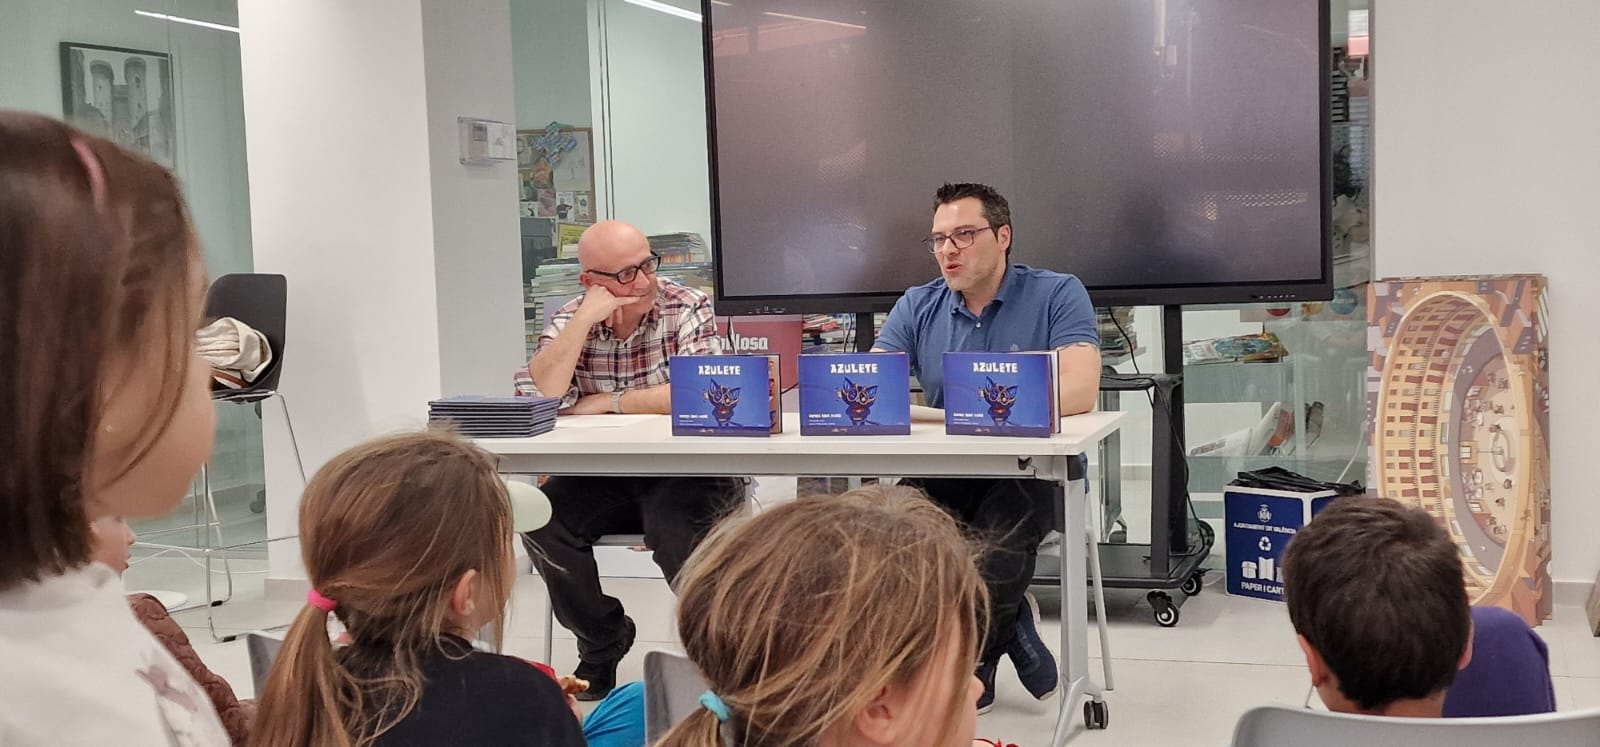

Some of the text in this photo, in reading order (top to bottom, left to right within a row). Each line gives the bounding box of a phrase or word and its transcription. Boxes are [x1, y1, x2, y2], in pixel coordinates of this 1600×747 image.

[698, 365, 741, 376] AZULETE
[830, 363, 879, 374] AZULETE
[972, 362, 1018, 373] AZULETE
[1241, 581, 1263, 592] PAPER
[1267, 585, 1285, 595] CART
